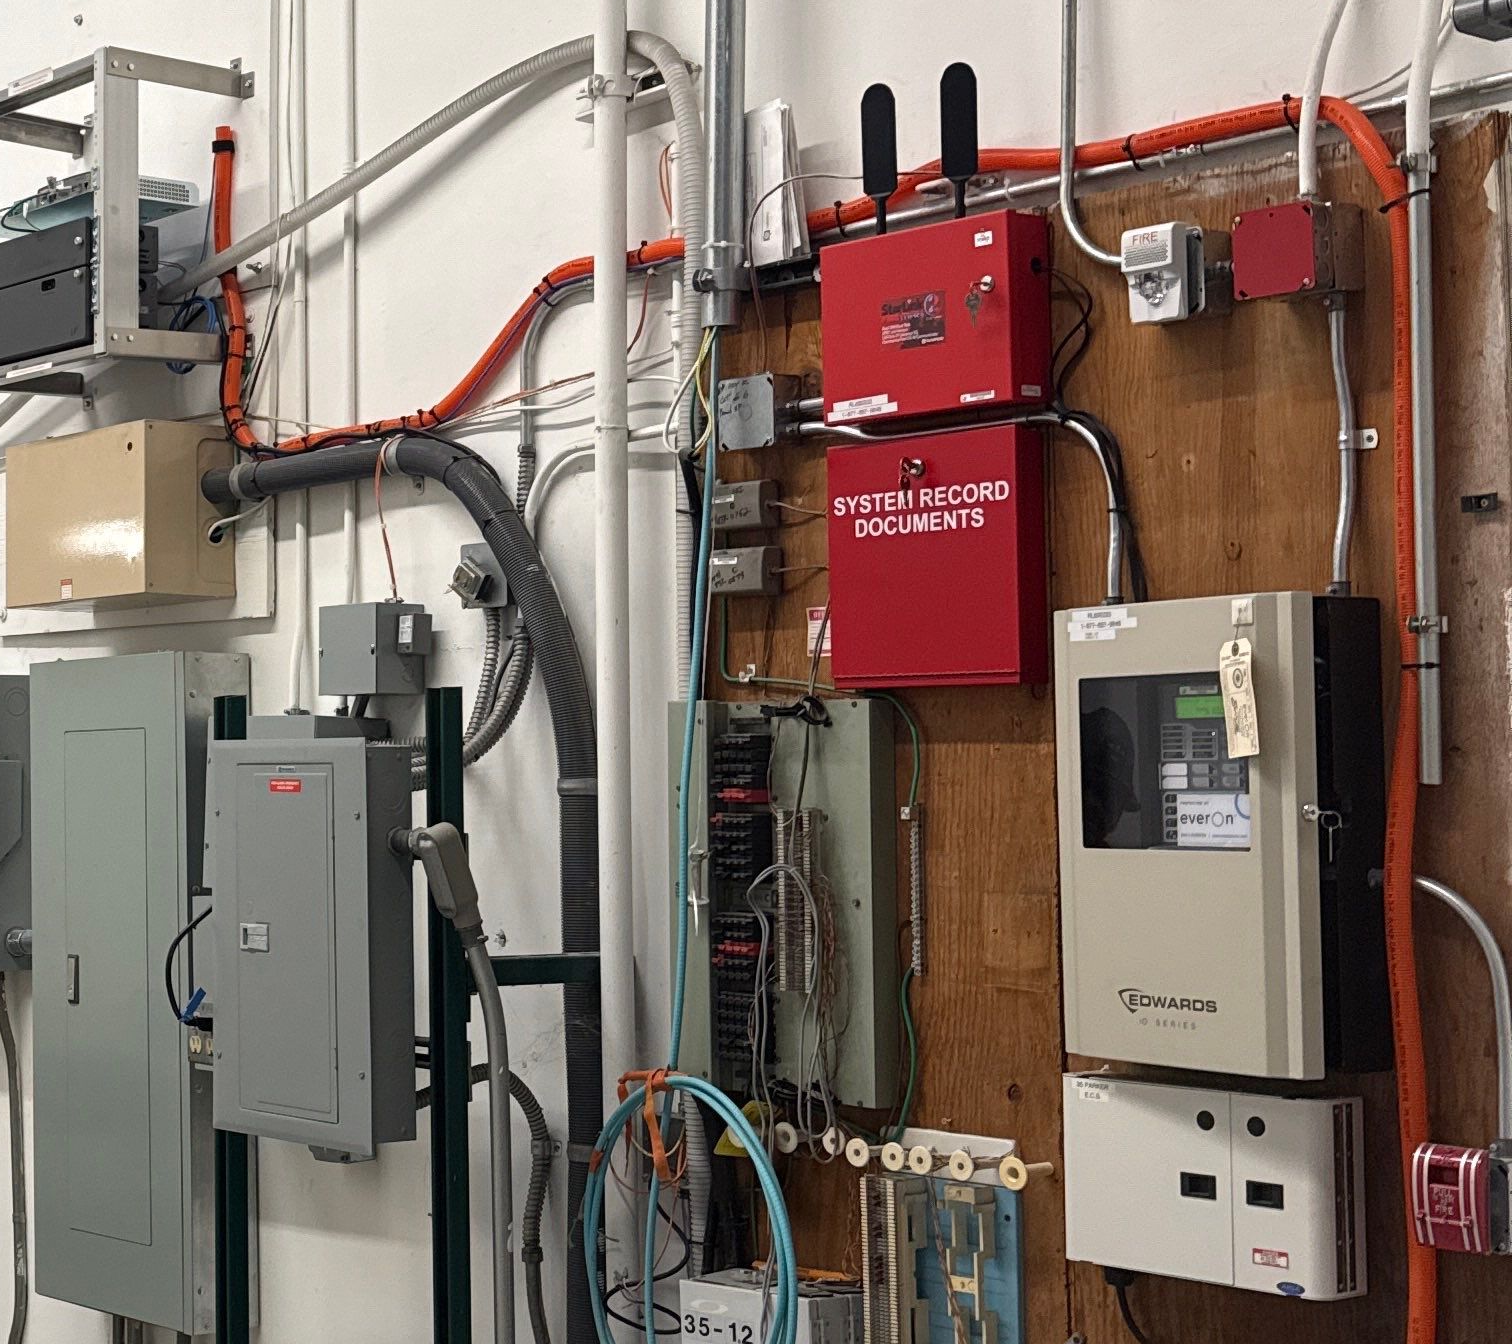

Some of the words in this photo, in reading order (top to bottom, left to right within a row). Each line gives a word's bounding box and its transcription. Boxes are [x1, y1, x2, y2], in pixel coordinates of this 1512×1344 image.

[1132, 231, 1159, 246] FIRE
[833, 489, 913, 517] SYSTEM
[919, 480, 1010, 508] RECORD
[855, 507, 985, 538] DOCUMENTS
[1128, 993, 1217, 1013] EDWARDS
[1155, 1018, 1196, 1031] SERIES
